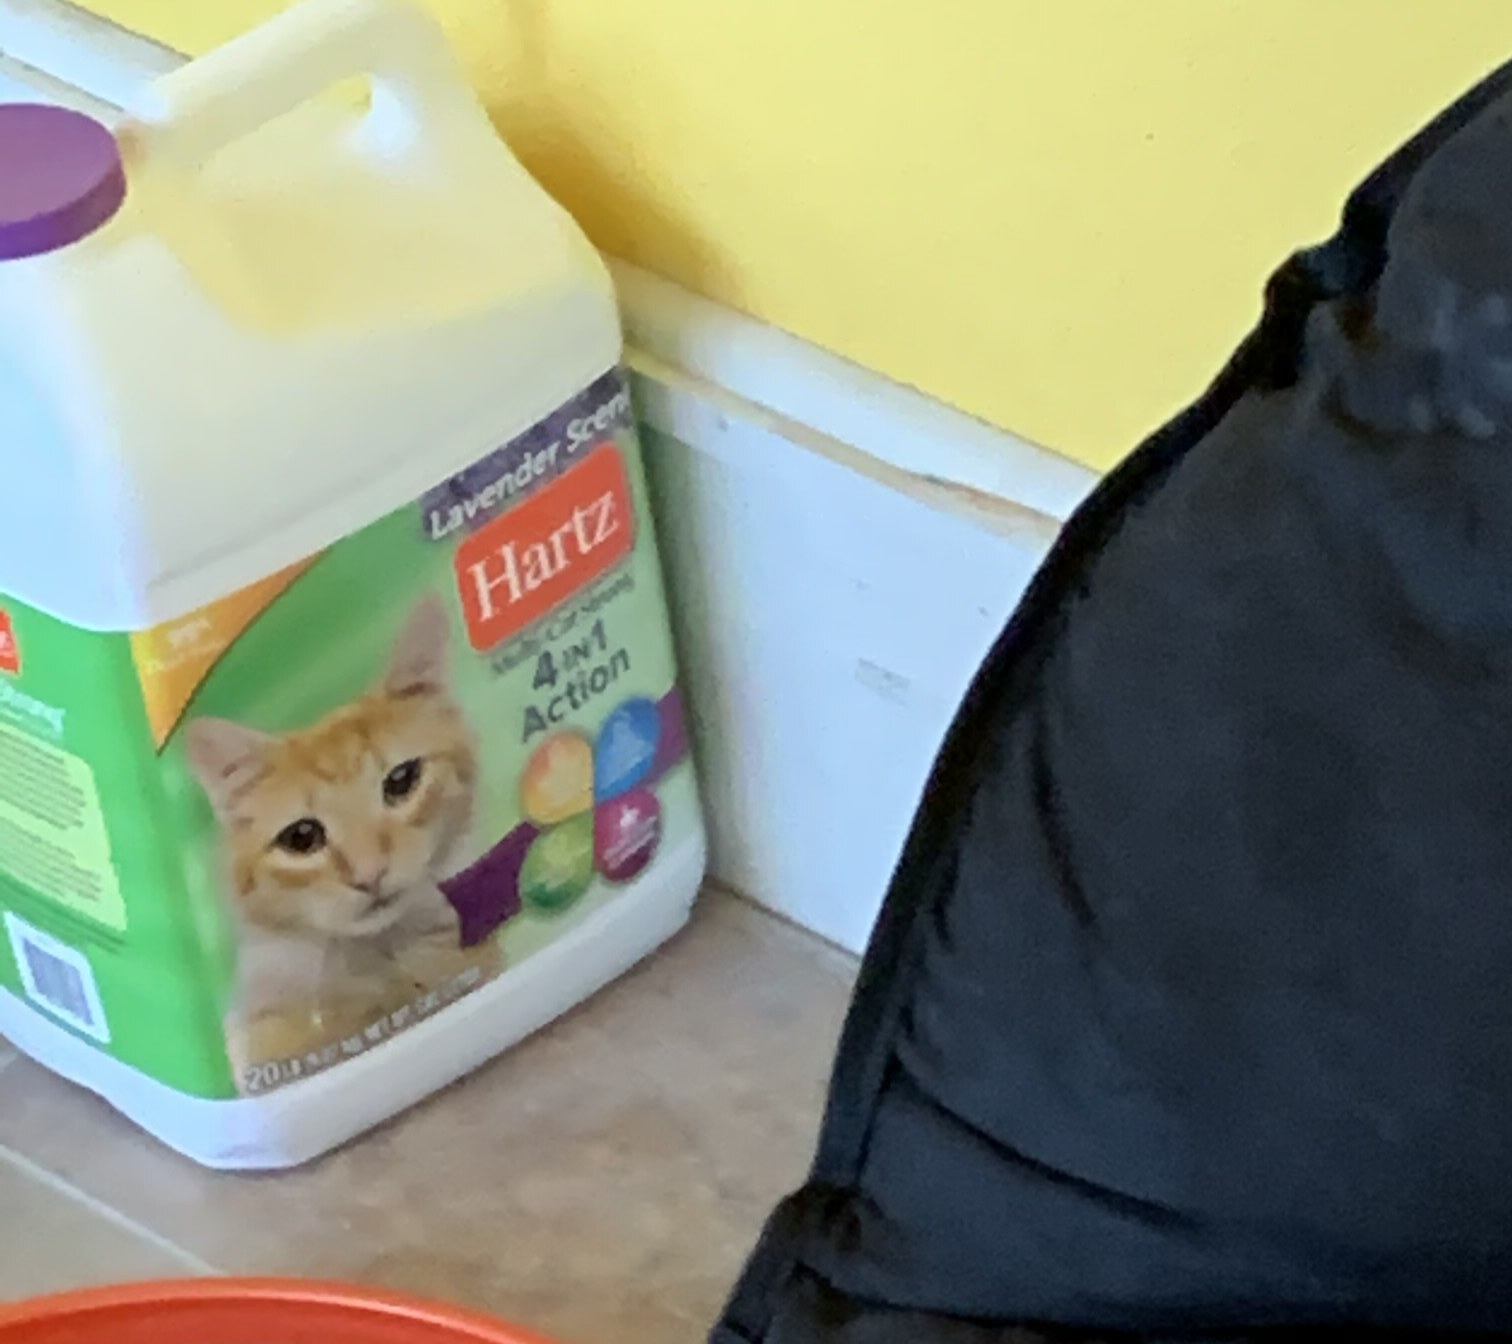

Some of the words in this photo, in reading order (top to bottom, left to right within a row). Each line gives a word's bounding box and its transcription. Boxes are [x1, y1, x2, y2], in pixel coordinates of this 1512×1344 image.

[428, 442, 561, 540] Lavender
[466, 490, 619, 622] Hartz
[521, 647, 631, 744] Action
[532, 650, 558, 690] 4
[246, 1061, 280, 1091] 20
